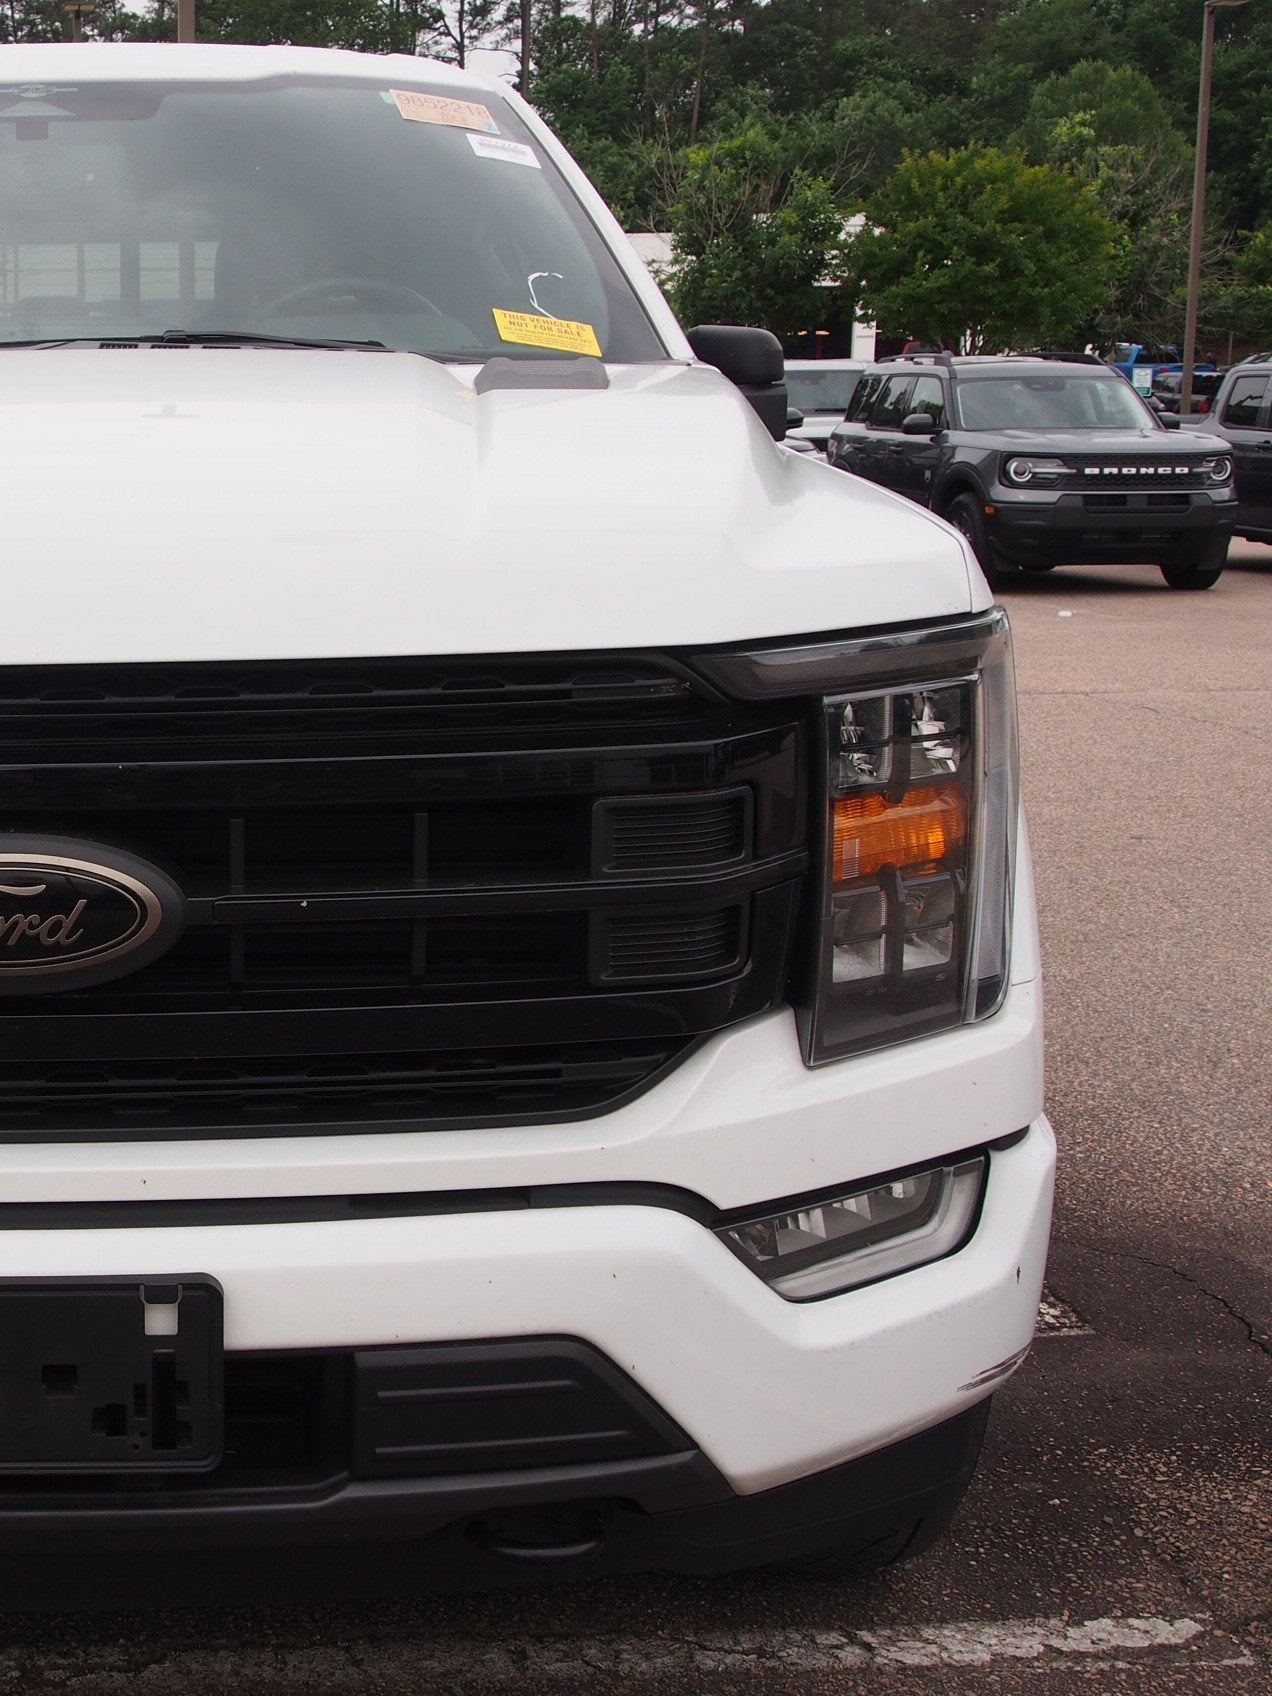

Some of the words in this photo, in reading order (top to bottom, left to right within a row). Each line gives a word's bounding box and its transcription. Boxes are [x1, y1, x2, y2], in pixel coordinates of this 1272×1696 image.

[502, 312, 526, 321] THIS
[528, 316, 571, 329] VEHICLE
[576, 324, 586, 332] IS
[508, 320, 529, 329] NOT
[533, 324, 554, 333] FOR
[557, 328, 584, 337] SALE
[1084, 467, 1189, 475] BRONCO
